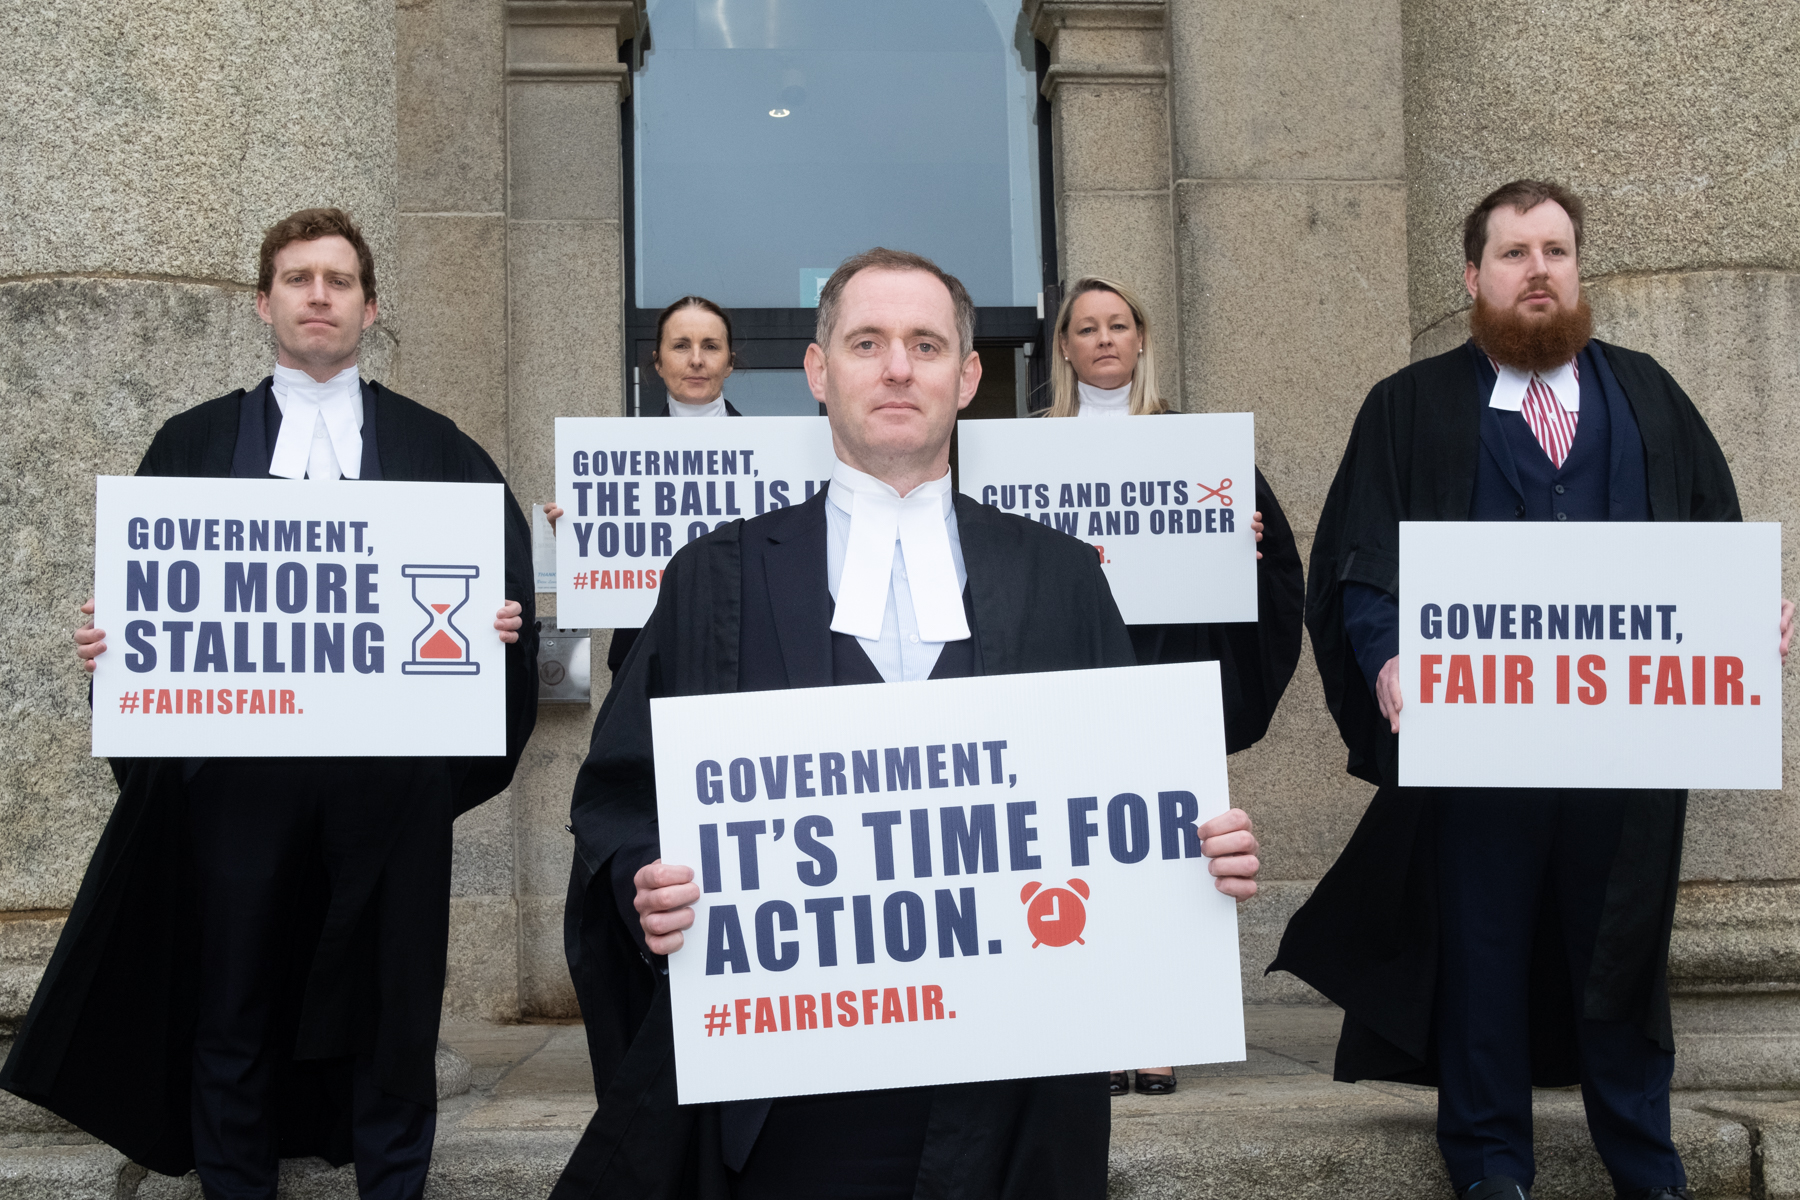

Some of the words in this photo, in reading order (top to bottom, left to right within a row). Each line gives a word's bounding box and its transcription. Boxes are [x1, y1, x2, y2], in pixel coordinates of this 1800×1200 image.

[573, 450, 759, 477] GOVERNMENT,
[573, 481, 640, 517] THE
[655, 481, 741, 516] BALL
[755, 480, 790, 515] IS
[982, 484, 1050, 509] CUTS
[1059, 483, 1111, 508] AND
[1121, 480, 1189, 506] CUTS
[128, 517, 374, 556] GOVERNMENT,
[573, 521, 675, 558] YOUR
[1088, 511, 1140, 536] AND
[1150, 508, 1235, 534] ORDER
[127, 560, 200, 613] NO
[224, 562, 379, 614] MORE
[573, 570, 665, 590] #FAIRIS
[1420, 603, 1683, 645] GOVERNMENT,
[125, 620, 385, 674] STALLING
[1420, 654, 1534, 704] FAIR
[1556, 654, 1607, 706] IS
[1629, 655, 1761, 706] FAIR.
[119, 688, 304, 715] #FAIRISFAIR.
[695, 740, 1018, 805] GOVERNMENT,
[698, 814, 838, 893] IT'S
[862, 800, 1043, 881] TIME
[1067, 790, 1202, 867] FOR
[705, 887, 1003, 976] ACTION.
[704, 984, 957, 1037] #FAIRISFAIR.
